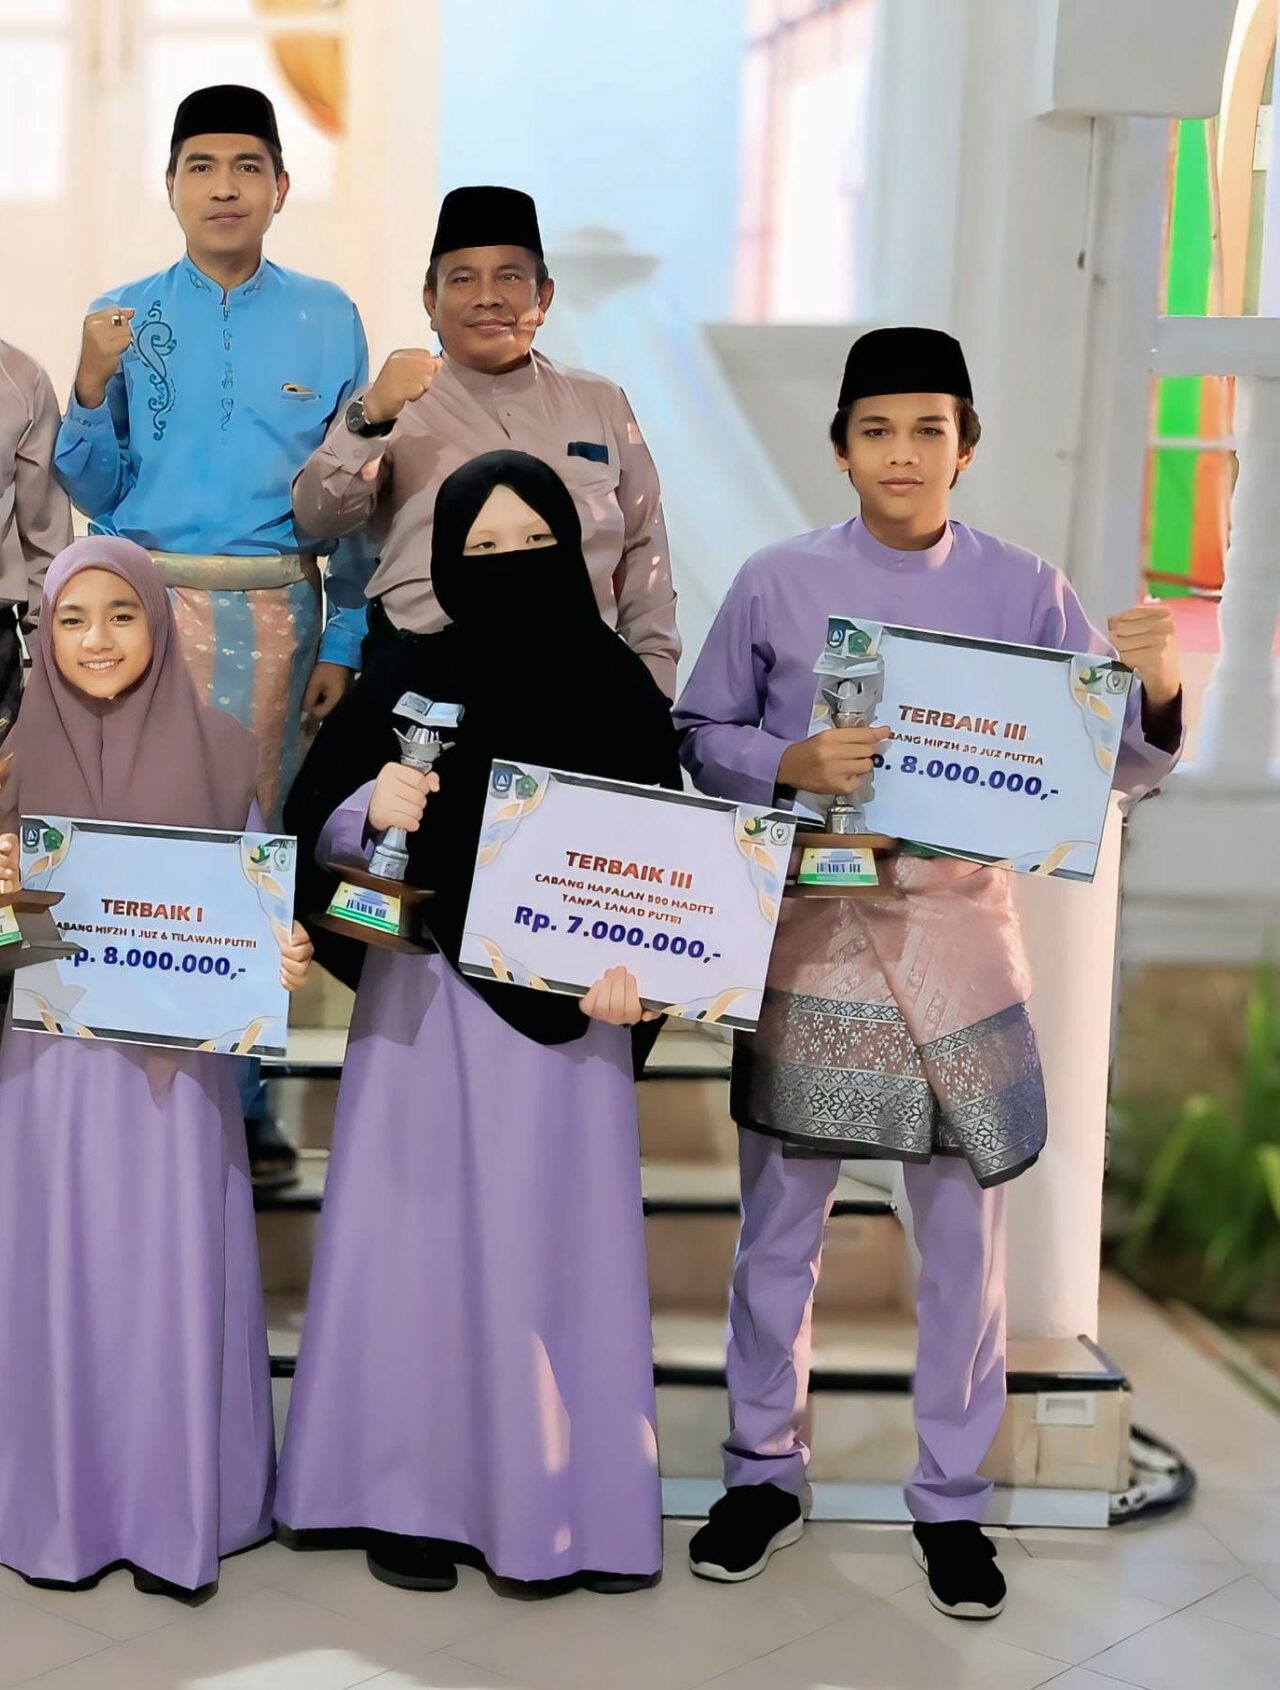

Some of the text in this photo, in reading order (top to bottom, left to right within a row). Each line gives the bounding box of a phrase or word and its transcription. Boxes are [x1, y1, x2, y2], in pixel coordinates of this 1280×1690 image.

[899, 705, 1027, 741] TERBAIK III
[889, 732, 920, 744] BANG
[980, 748, 1001, 758] JUZ
[1005, 752, 1043, 765] PUTRA
[901, 755, 1058, 800] 8.000.000,-
[566, 851, 692, 889] TERBAIK III
[535, 874, 584, 889] CABANG
[587, 883, 644, 900] HAFALAN
[562, 894, 600, 908] TANPA
[101, 899, 202, 922] TERBAIK I
[57, 922, 92, 932] ABANG
[138, 930, 158, 939] JUZ
[161, 932, 167, 940] &
[172, 933, 221, 945] TILAWAH
[514, 906, 721, 963] Rp. 7.000.000,-
[60, 946, 245, 979] p. 8.000.000,-
